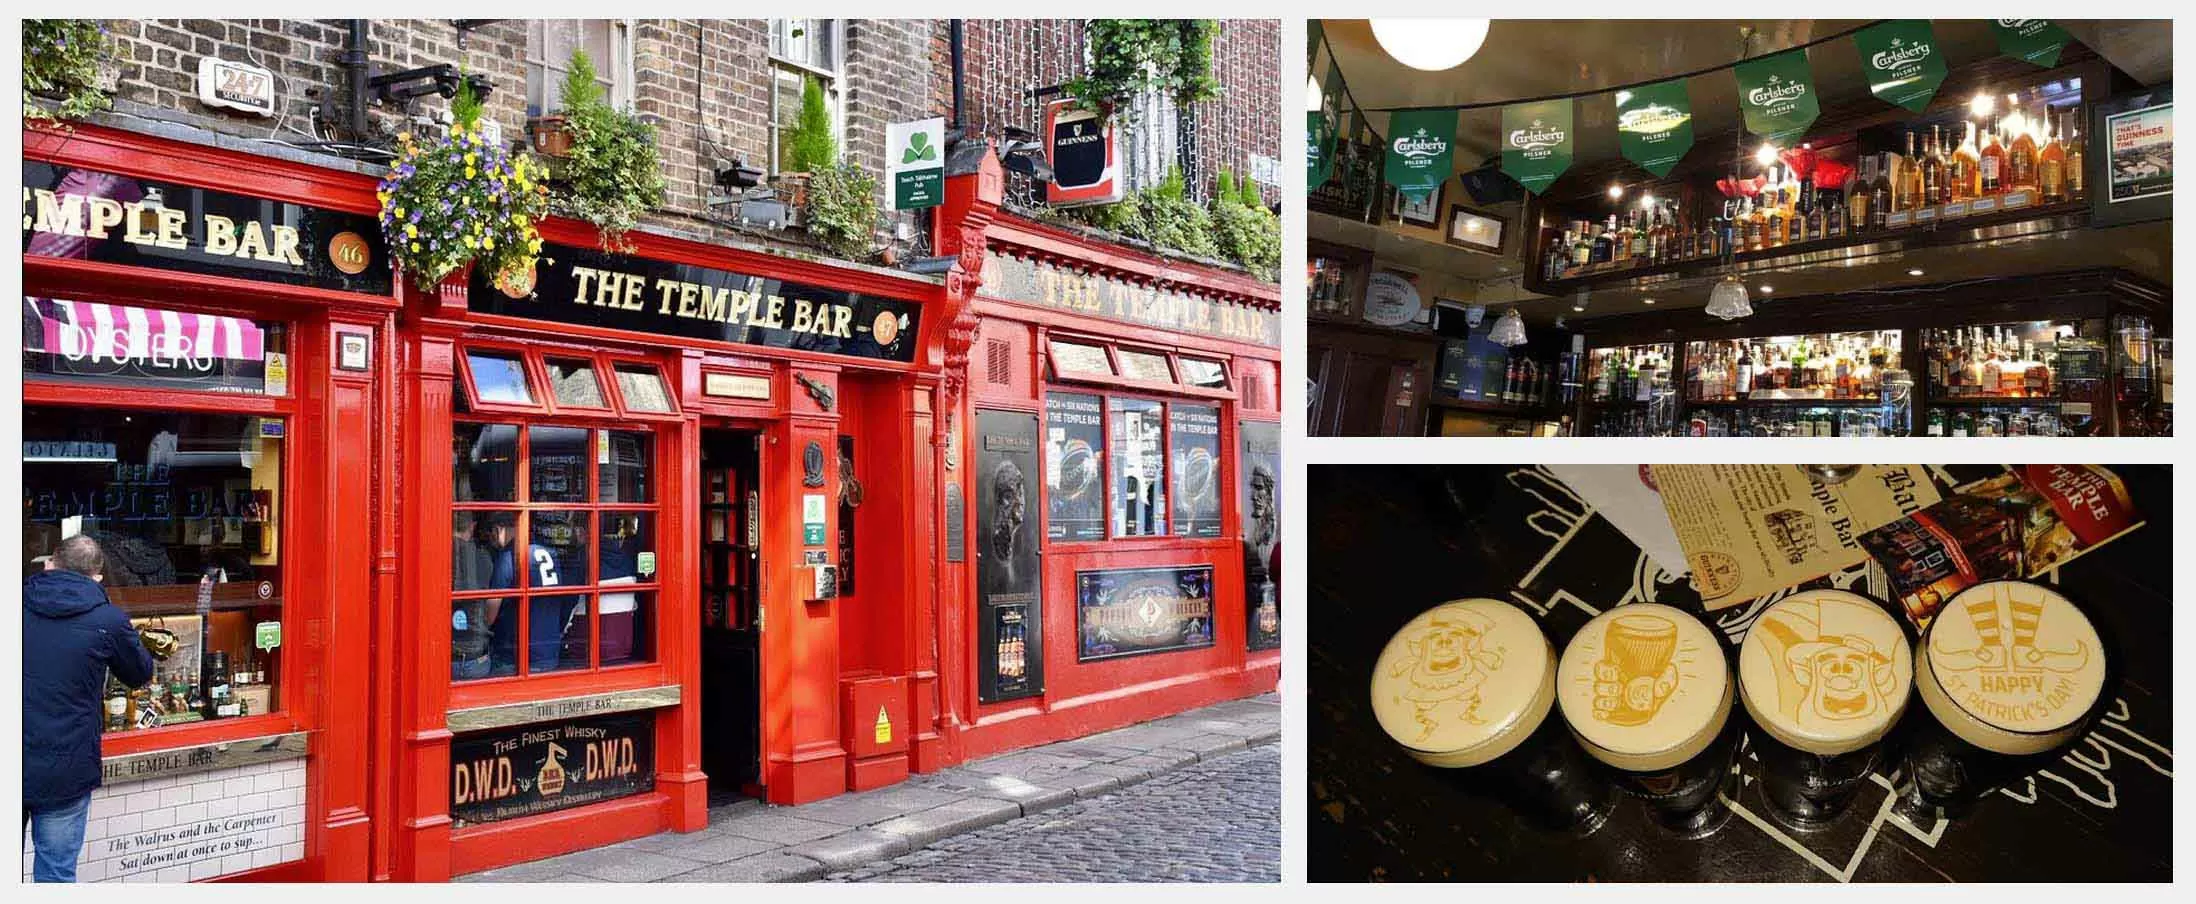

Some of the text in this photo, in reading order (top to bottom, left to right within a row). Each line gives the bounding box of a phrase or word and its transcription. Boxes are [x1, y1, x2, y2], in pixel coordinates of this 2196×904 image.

[1872, 42, 1930, 69] Carlsberg
[1749, 81, 1805, 105] Carlsberg
[1058, 134, 1098, 146] GUINNESS
[1394, 137, 1447, 155] Carlsberg
[1511, 127, 1564, 147] Carlsberg
[2116, 126, 2163, 141] GUINNESS
[204, 214, 303, 266] BAR
[339, 243, 364, 264] 46
[572, 266, 853, 338] THE TEMPLE BAR
[1038, 267, 1265, 341] THE TEMPLE BAR
[58, 323, 213, 371] OYSTERS
[1063, 413, 1087, 423] TEMPLE
[2049, 464, 2109, 521] TEMPLE
[2080, 467, 2106, 489] THE
[2048, 480, 2084, 511] BAR
[1831, 516, 1858, 549] Bar
[534, 549, 559, 586] 2
[1981, 675, 2044, 694] HAPPY
[559, 700, 592, 716] TEMPLE
[596, 698, 612, 710] BAR
[1966, 690, 2049, 721] PATRICK'S
[493, 724, 607, 755] THE FINEST WHISKY
[130, 755, 181, 775] TEMPLE
[188, 750, 213, 767] BAR
[586, 737, 637, 781] D.W.D.
[455, 757, 517, 804] D.W.D.
[107, 814, 276, 852] The Walrus and the Carpenter
[119, 857, 138, 871] Sat
[142, 853, 174, 867] down
[176, 850, 188, 860] at
[192, 845, 216, 857] once
[220, 840, 231, 851] to
